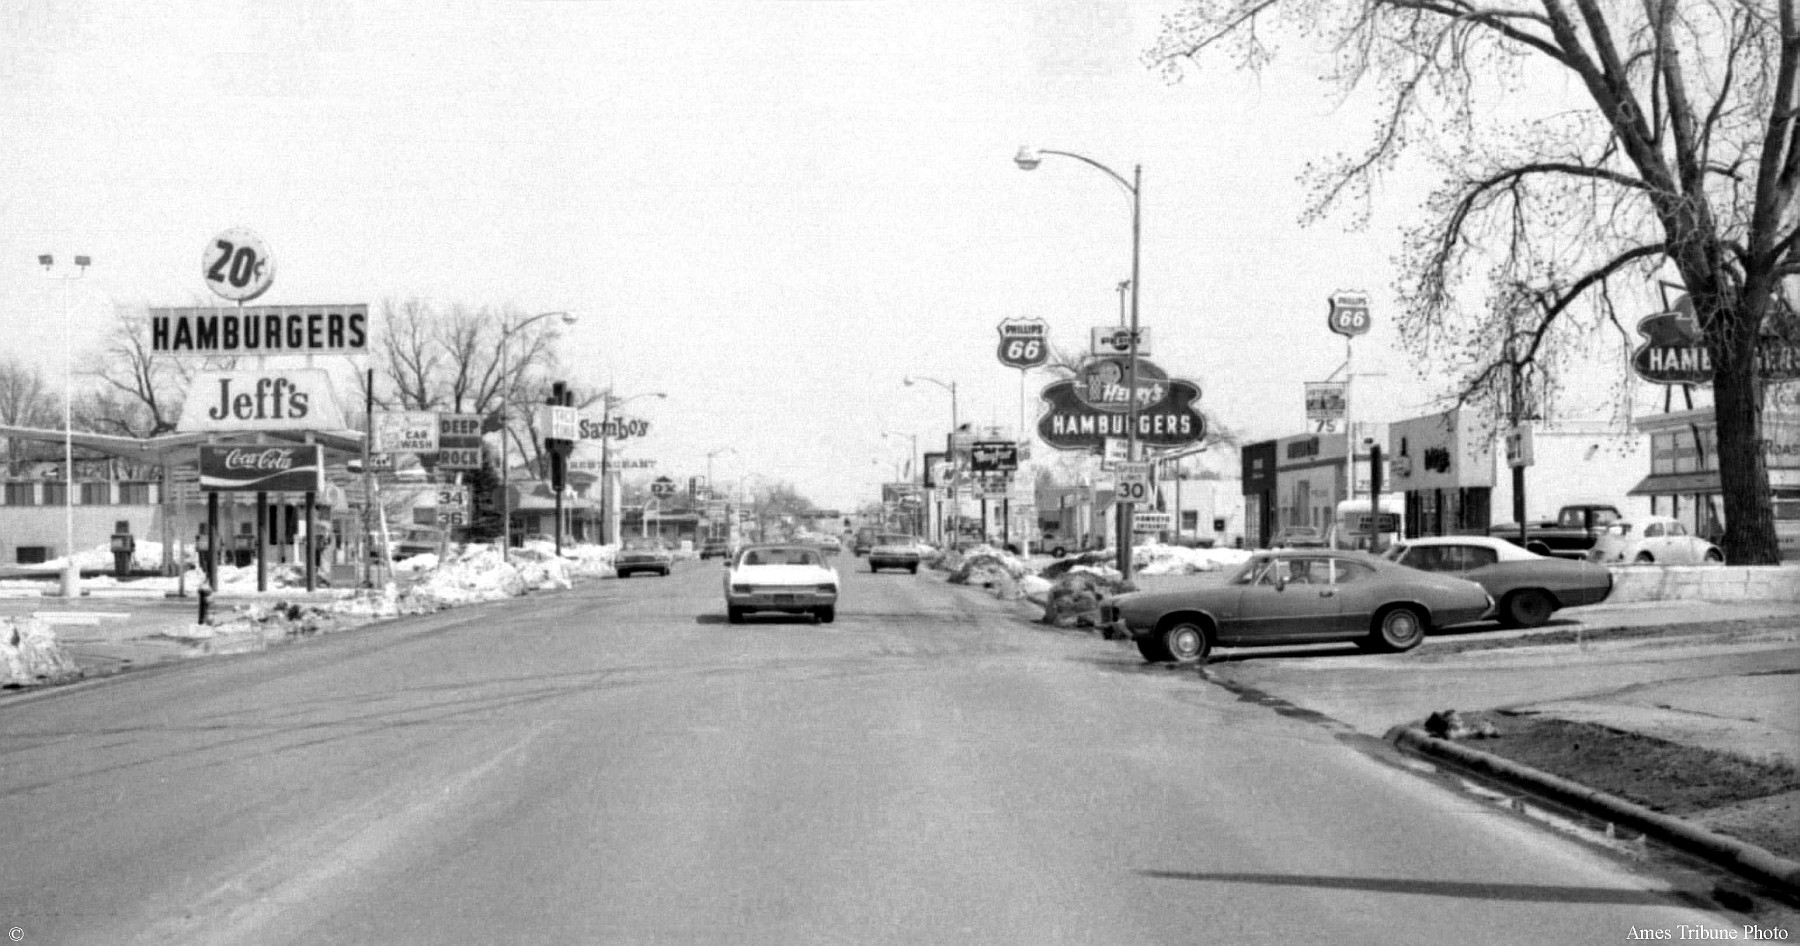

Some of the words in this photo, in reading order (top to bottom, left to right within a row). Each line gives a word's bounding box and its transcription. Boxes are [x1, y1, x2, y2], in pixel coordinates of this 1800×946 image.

[207, 239, 265, 288] 20¢
[1340, 311, 1365, 326] 66
[152, 313, 366, 350] HAMBURGERS
[1005, 324, 1043, 335] PHILLIPS
[1008, 340, 1041, 359] 66
[208, 377, 309, 420] Jeff's
[442, 420, 479, 434] DEEP
[579, 416, 649, 440] Sambo's
[1052, 414, 1190, 435] HAMBUGERS
[1315, 419, 1335, 432] 75
[405, 431, 428, 439] CAR
[402, 440, 432, 449] WASH
[440, 452, 478, 466] ROCK
[569, 459, 657, 470] RESTAURANT
[1117, 465, 1146, 473] SPEED
[651, 484, 676, 495] DX
[1118, 482, 1145, 499] 30
[438, 491, 463, 505] 34
